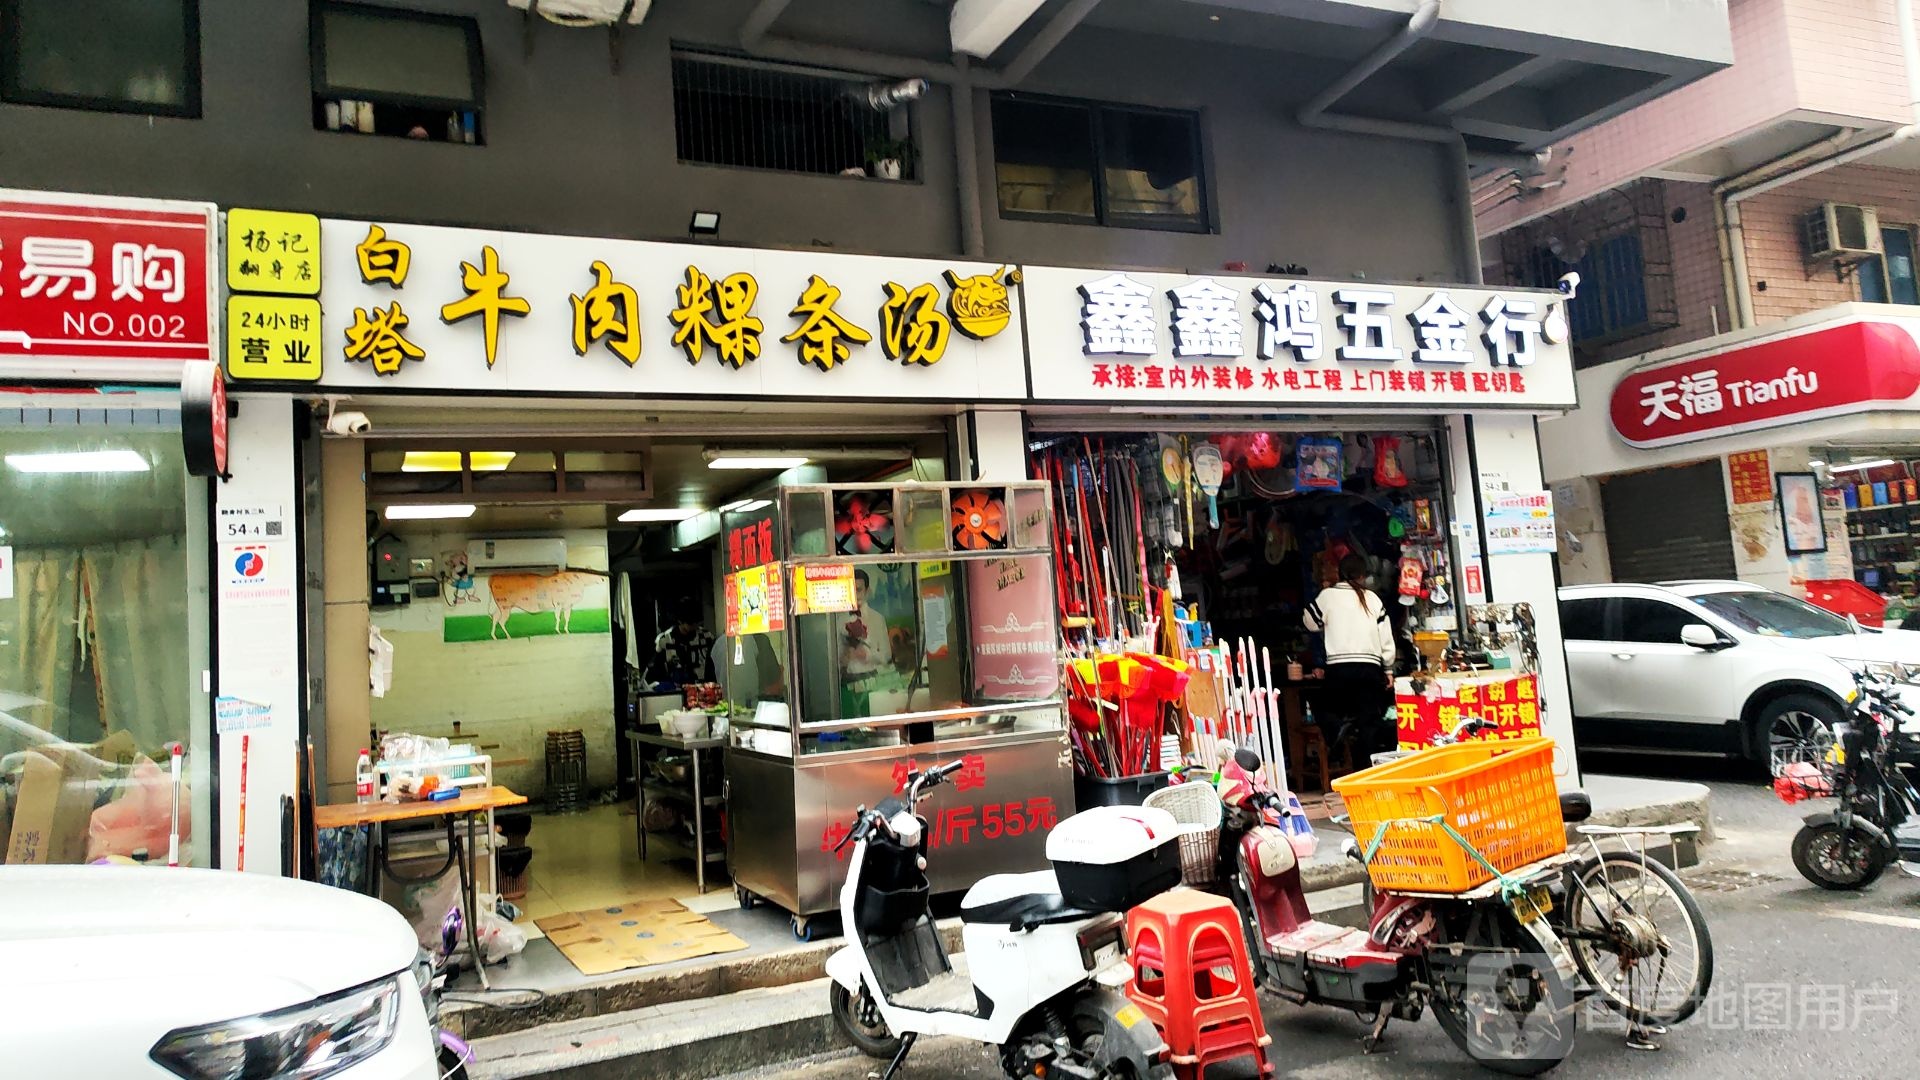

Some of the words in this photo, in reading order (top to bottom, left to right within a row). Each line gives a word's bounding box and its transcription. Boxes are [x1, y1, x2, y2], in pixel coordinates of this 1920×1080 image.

[0, 236, 185, 303] 易购
[63, 311, 186, 338] NO.002
[241, 311, 310, 331] 24小时
[344, 224, 427, 376] 白塔
[440, 244, 951, 372] 牛肉粿条汤
[1077, 273, 1542, 367] 鑫鑫鸿五金行
[241, 337, 312, 364] 营业
[1261, 367, 1342, 390] 水电工程
[1350, 369, 1426, 391] 上门装锁
[1430, 371, 1467, 392] 开锁
[1471, 371, 1526, 393] 配钥匙
[1639, 369, 1723, 426] 天福
[1725, 366, 1819, 408] Tianfu
